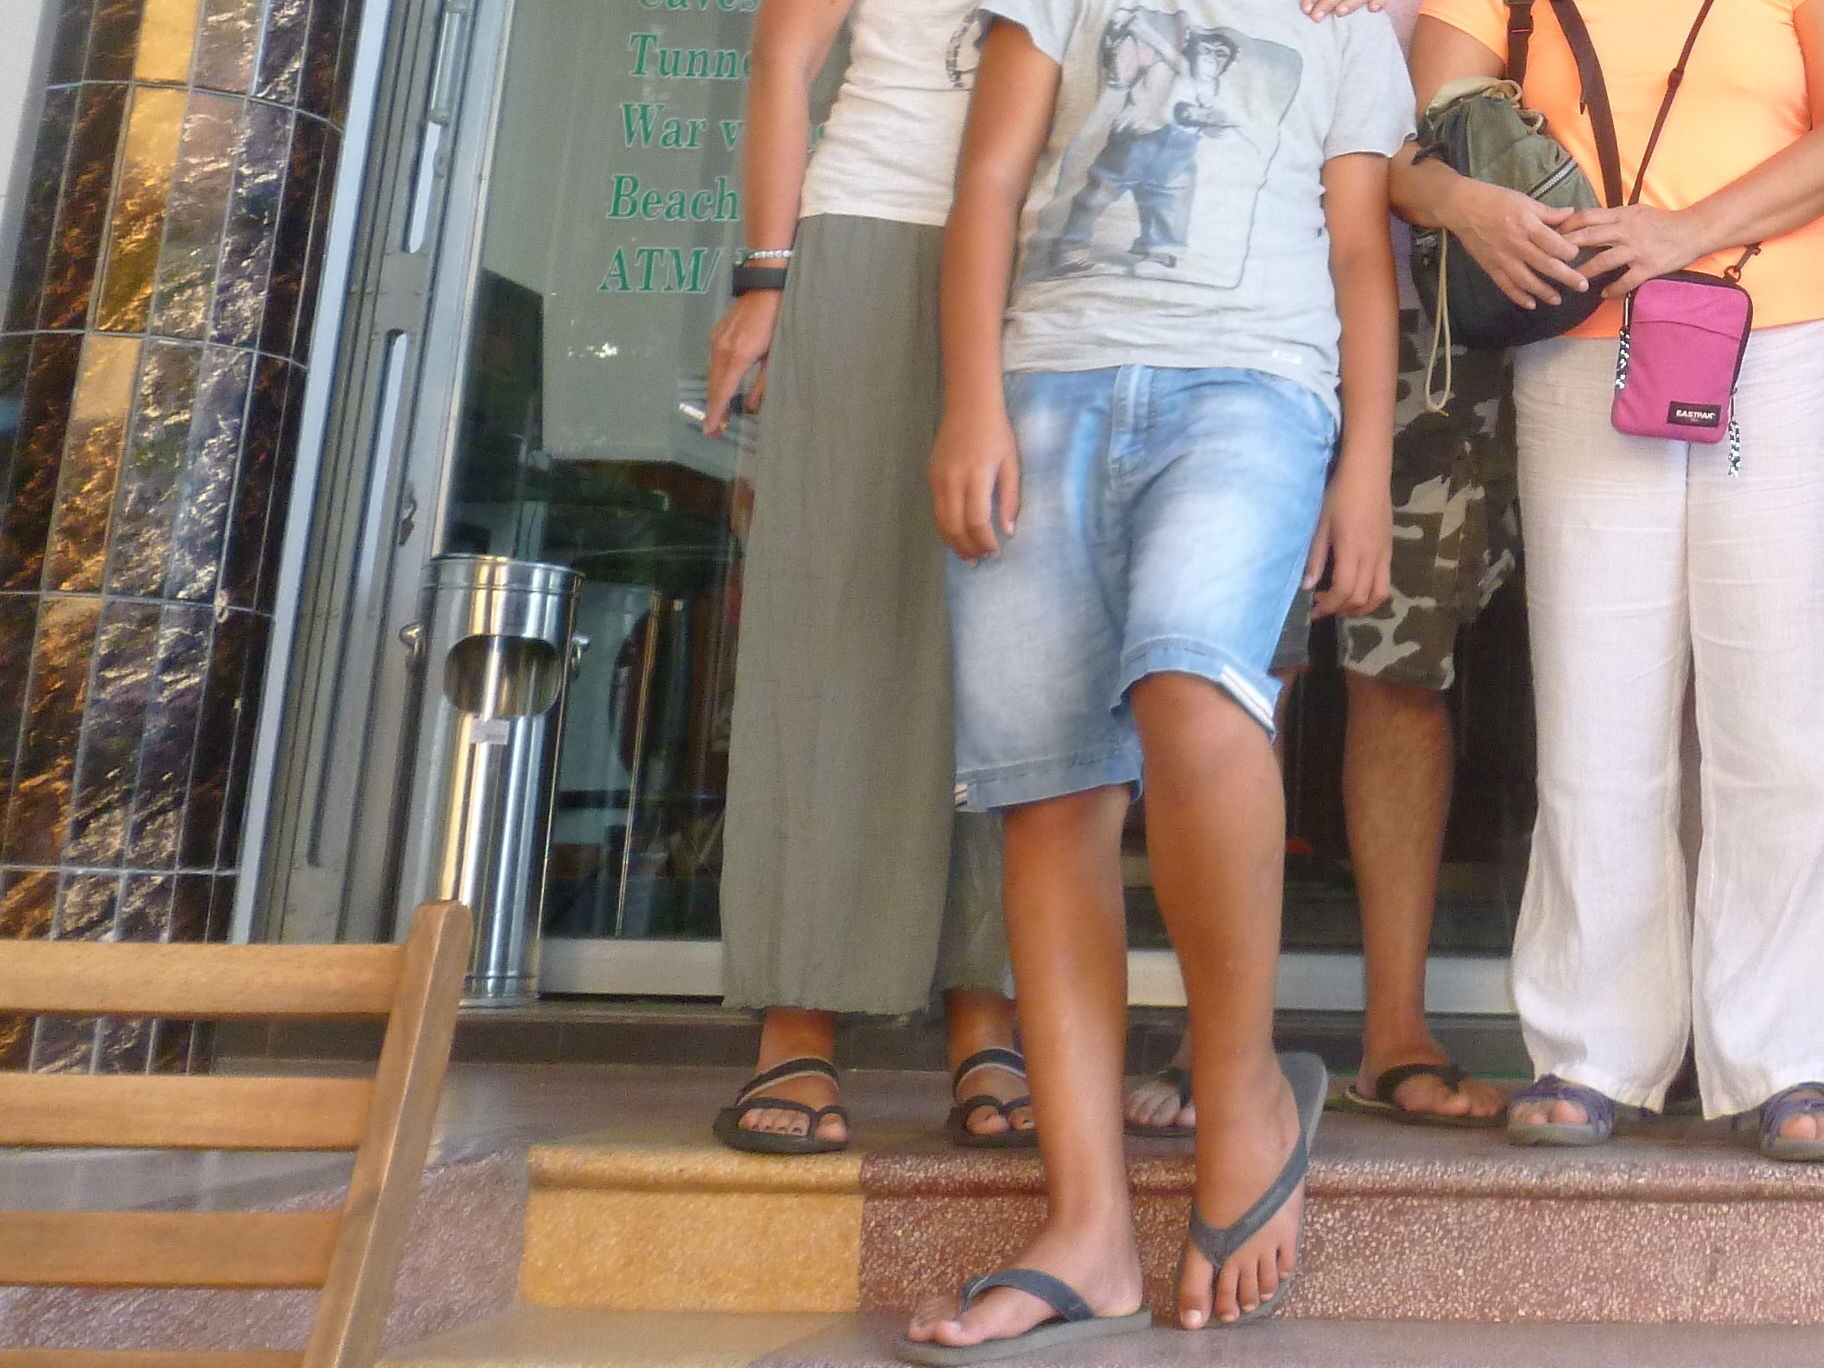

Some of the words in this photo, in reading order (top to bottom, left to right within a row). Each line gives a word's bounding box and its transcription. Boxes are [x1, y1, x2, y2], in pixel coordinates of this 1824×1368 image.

[619, 102, 707, 150] War
[606, 173, 740, 223] Beach
[1675, 409, 1716, 420] EASTPAK
